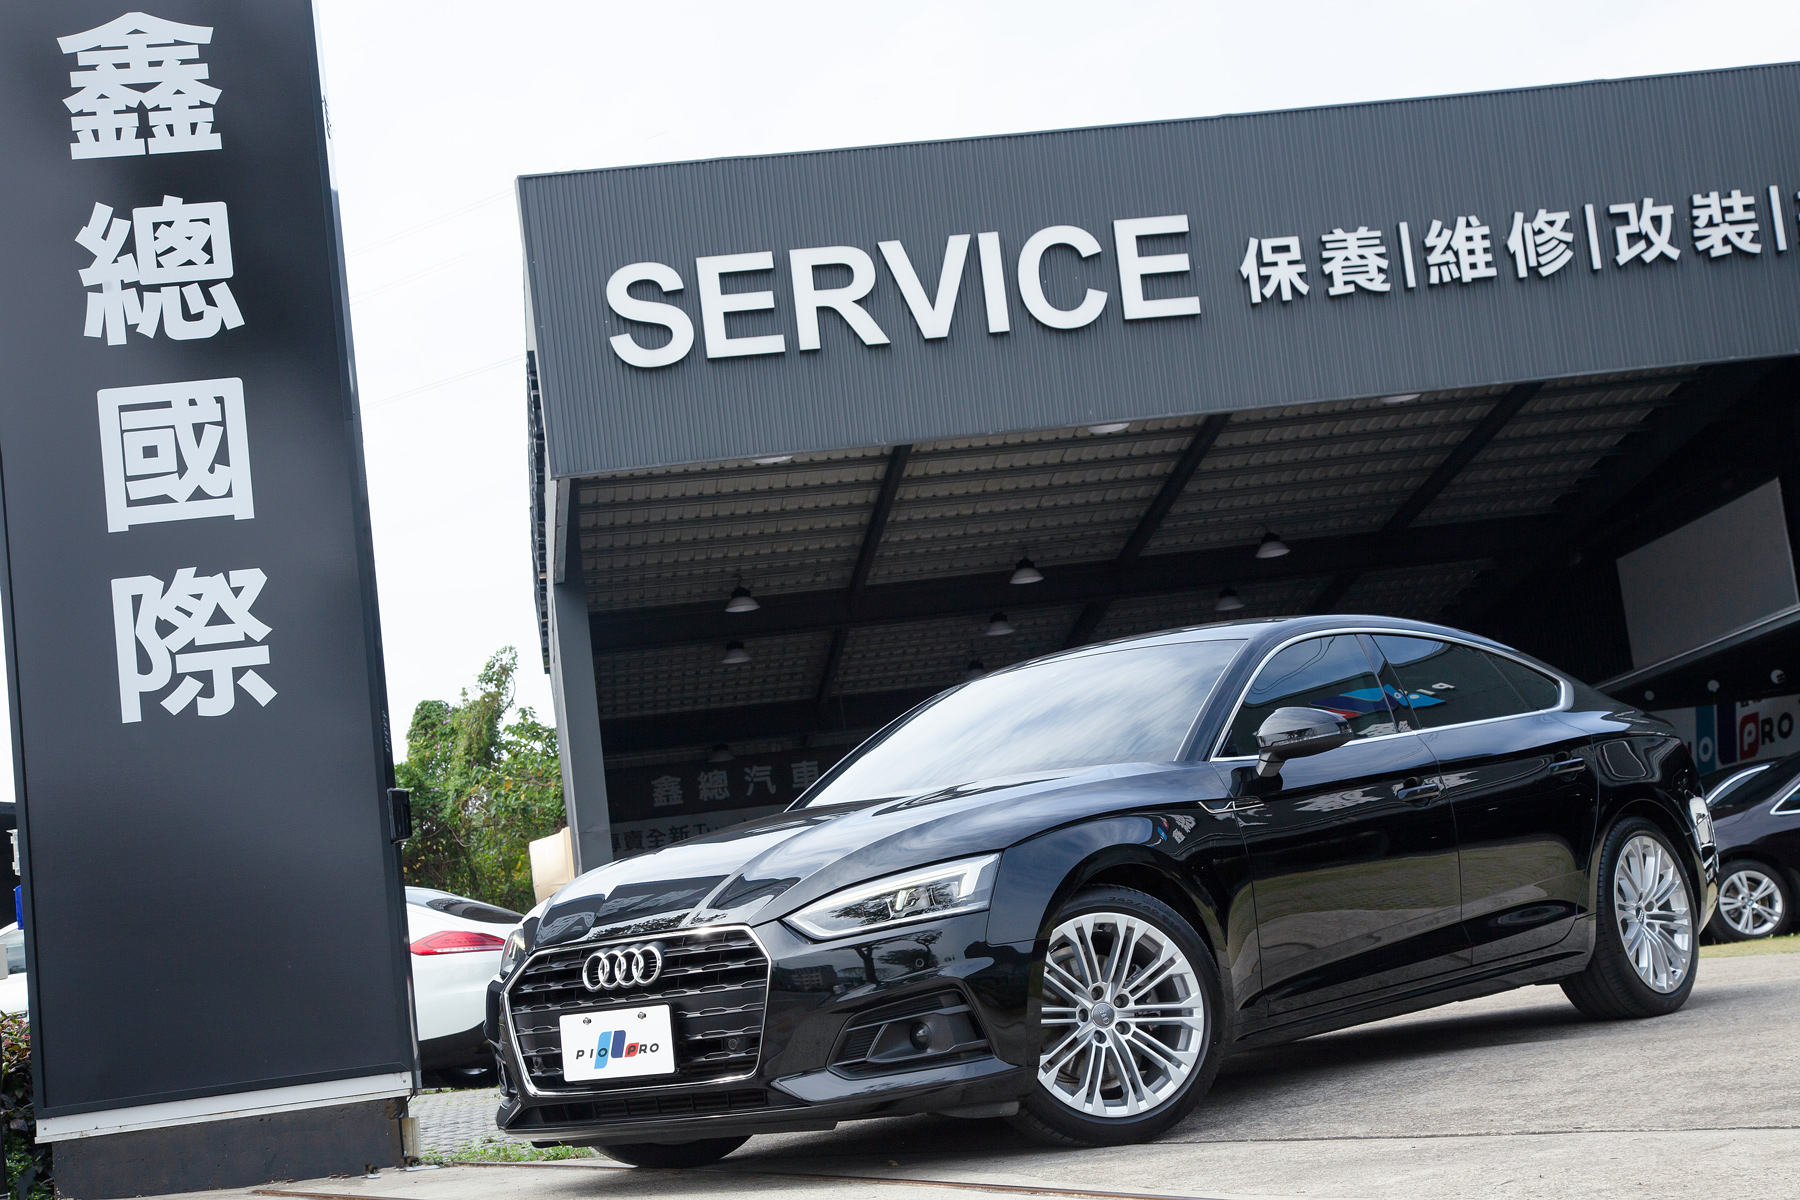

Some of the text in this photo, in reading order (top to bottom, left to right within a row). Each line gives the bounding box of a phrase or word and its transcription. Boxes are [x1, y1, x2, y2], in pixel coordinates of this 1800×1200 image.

[606, 215, 1201, 368] SERVICE
[57, 12, 277, 724] 鑫總國際
[1743, 712, 1794, 751] PRO
[651, 761, 820, 807] 鑫總汽車
[576, 1043, 660, 1060] PIO PRO
